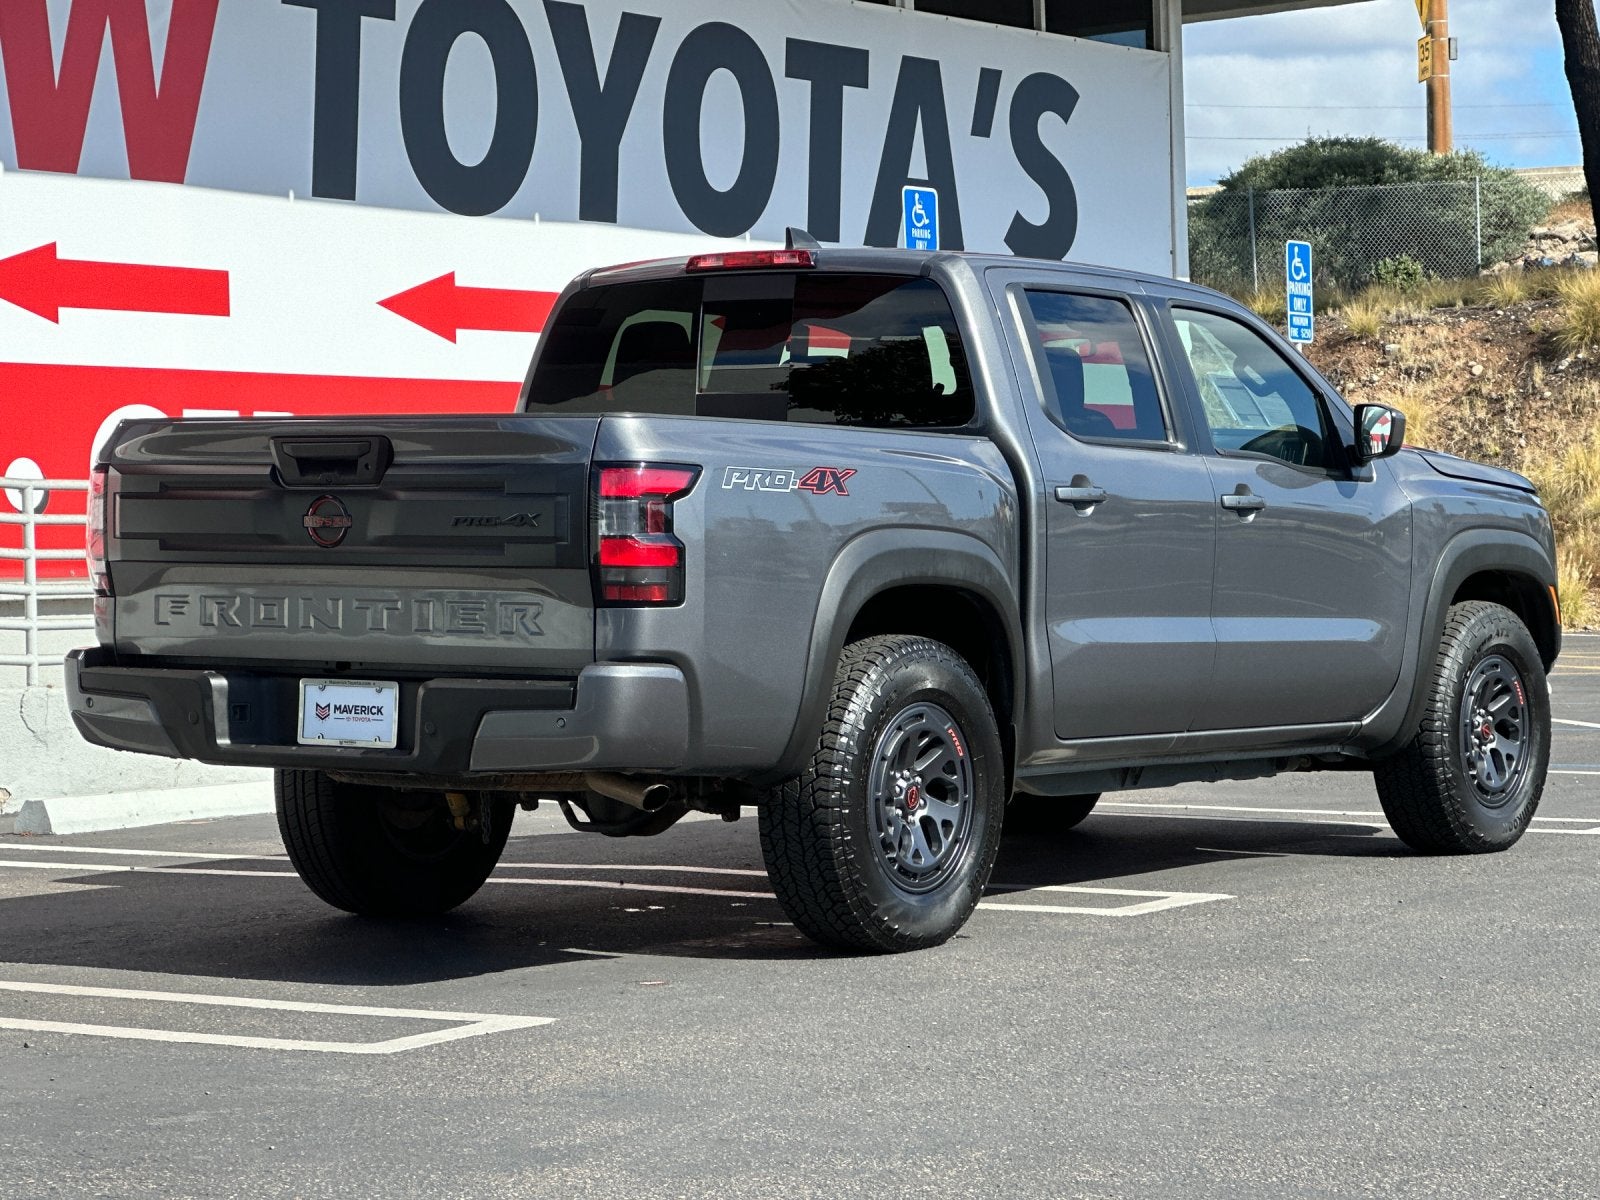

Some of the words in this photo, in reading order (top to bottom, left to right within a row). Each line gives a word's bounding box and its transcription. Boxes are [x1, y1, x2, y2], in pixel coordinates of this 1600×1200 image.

[1419, 42, 1430, 63] 35
[281, 0, 1080, 260] TOYOTA'S
[1289, 281, 1311, 296] PARKING
[1293, 297, 1307, 311] ONLY
[303, 515, 352, 528] NISSAN
[154, 594, 545, 637] FRONTIER
[333, 704, 384, 716] MAVERICK
